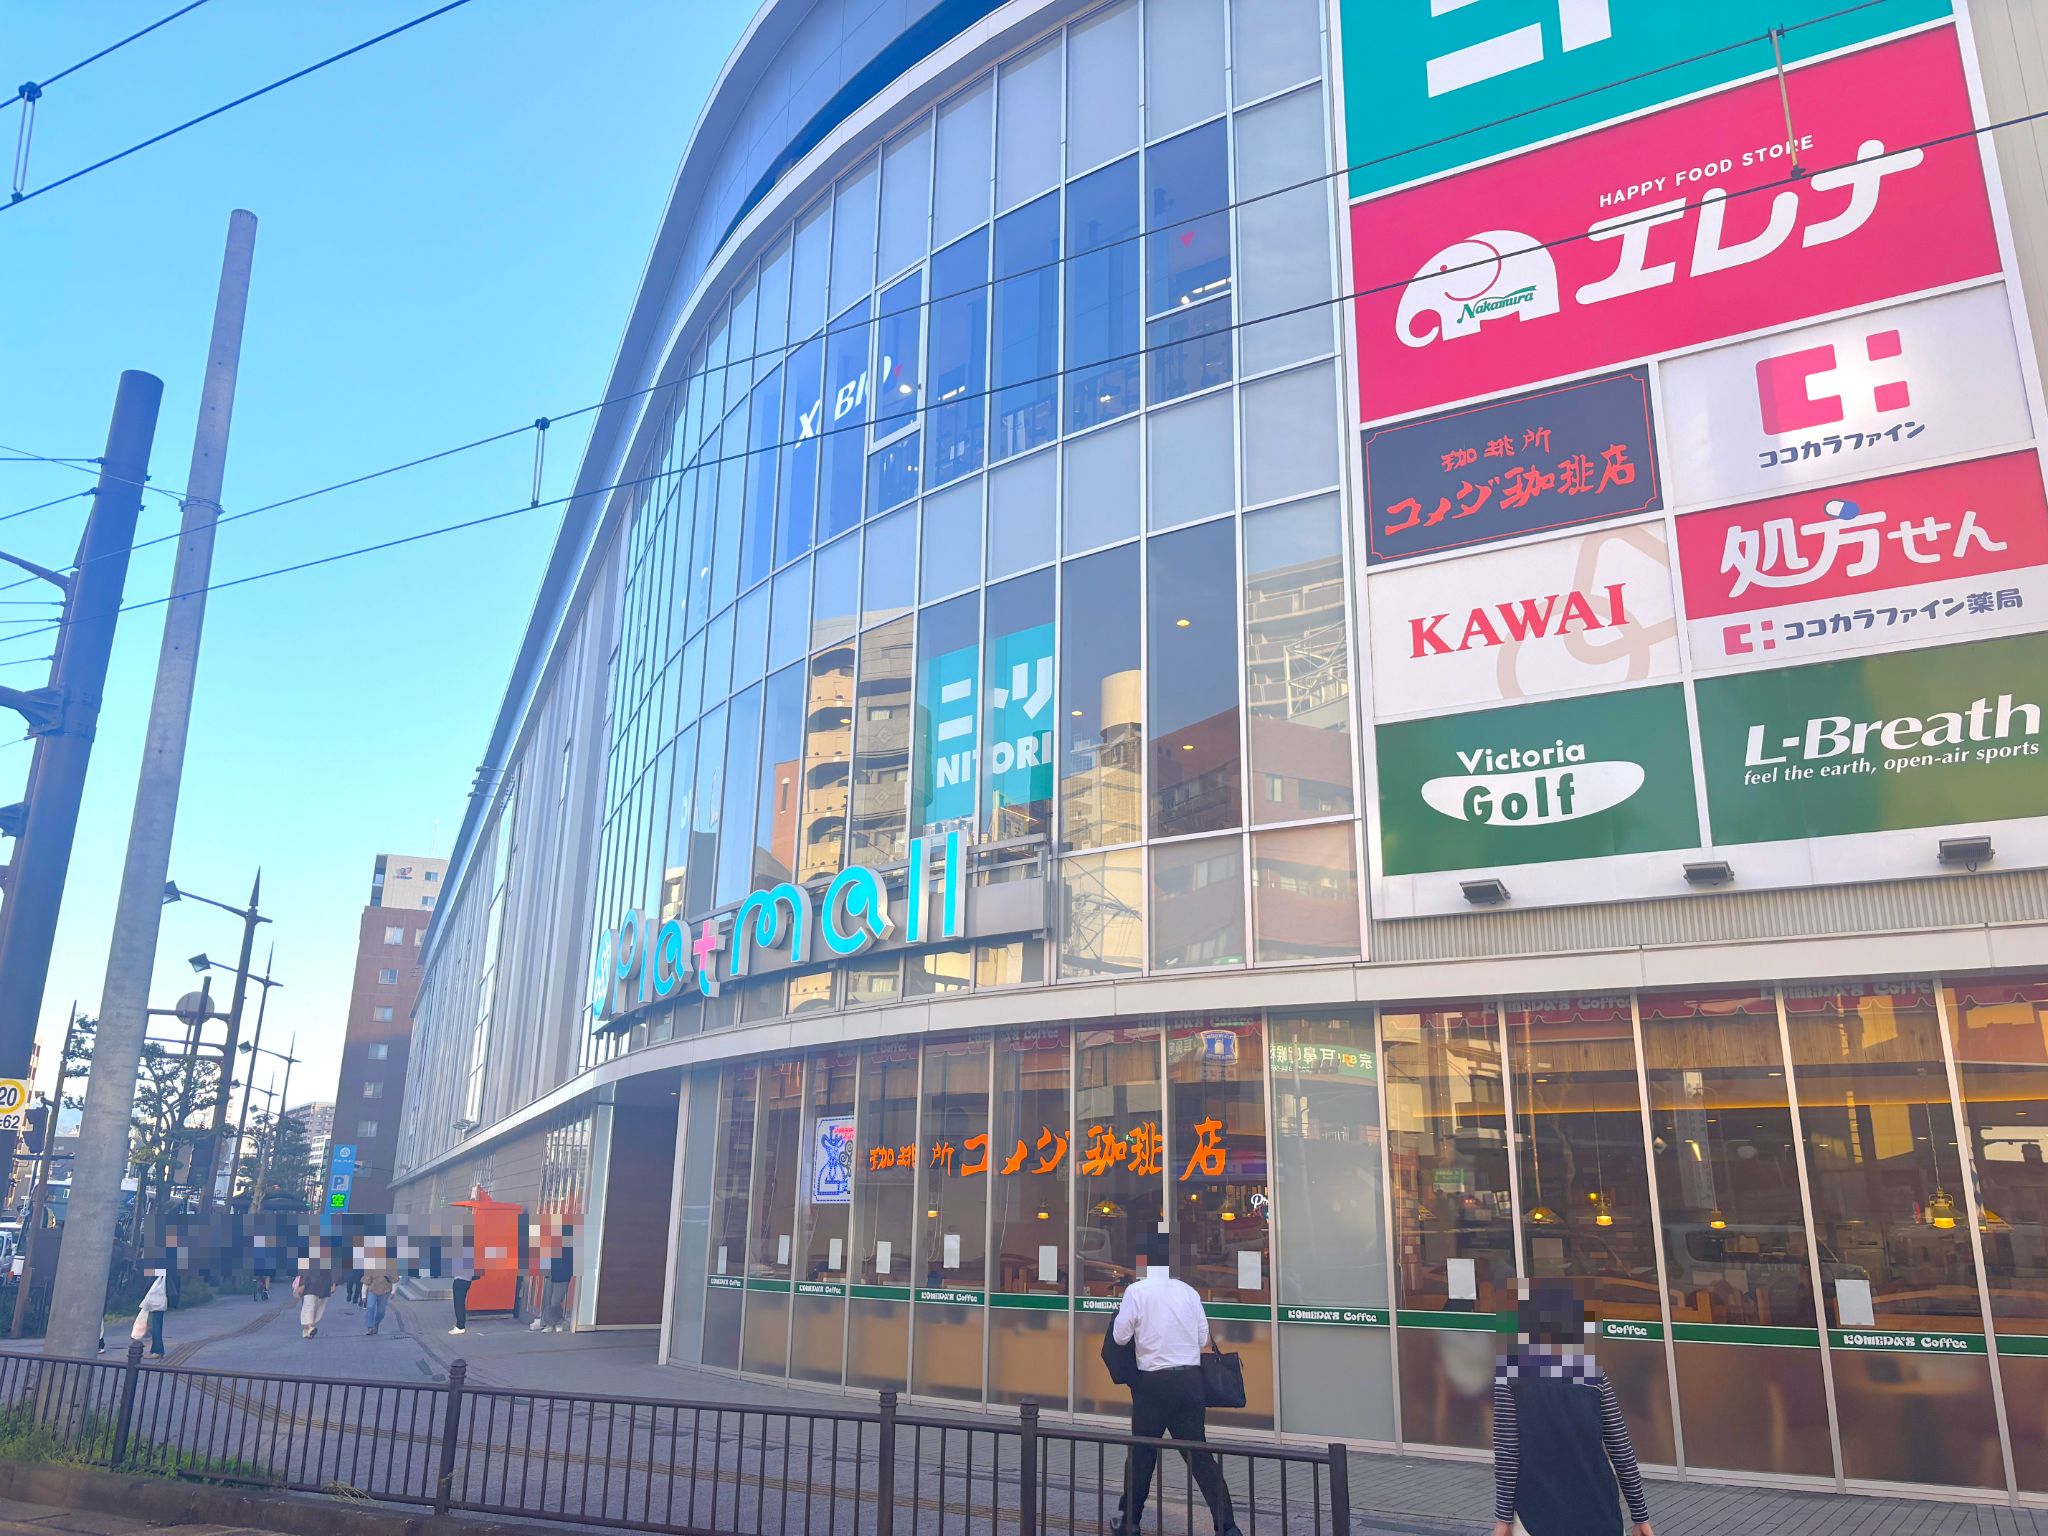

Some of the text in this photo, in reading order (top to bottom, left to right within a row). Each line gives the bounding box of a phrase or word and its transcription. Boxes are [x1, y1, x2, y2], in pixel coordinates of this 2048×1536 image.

[1599, 134, 1815, 208] HAPPY FOOD STORE
[1575, 139, 1925, 305] エレナ
[1457, 285, 1537, 324] Nakamura
[1758, 421, 1926, 469] ココカラファイン
[1720, 500, 2008, 598] 処方せん
[1407, 582, 1631, 659] KAWAI
[1783, 587, 2024, 641] ココカラファイン薬局
[1744, 694, 2042, 767] L-Breath
[1456, 739, 1586, 775] Victoria
[1743, 741, 2040, 785] feel the earth, open-air sports
[1462, 772, 1575, 825] Golf
[611, 831, 967, 1015] platmall
[331, 1193, 345, 1207] 空
[956, 1293, 978, 1303] Coffee
[1083, 1300, 1122, 1310] KOMEDA'
[1288, 1310, 1377, 1322] KOMEDA'S Coffee
[1607, 1324, 1648, 1336] Coffee
[1843, 1334, 1968, 1349] KOMEDA'S Coffee
